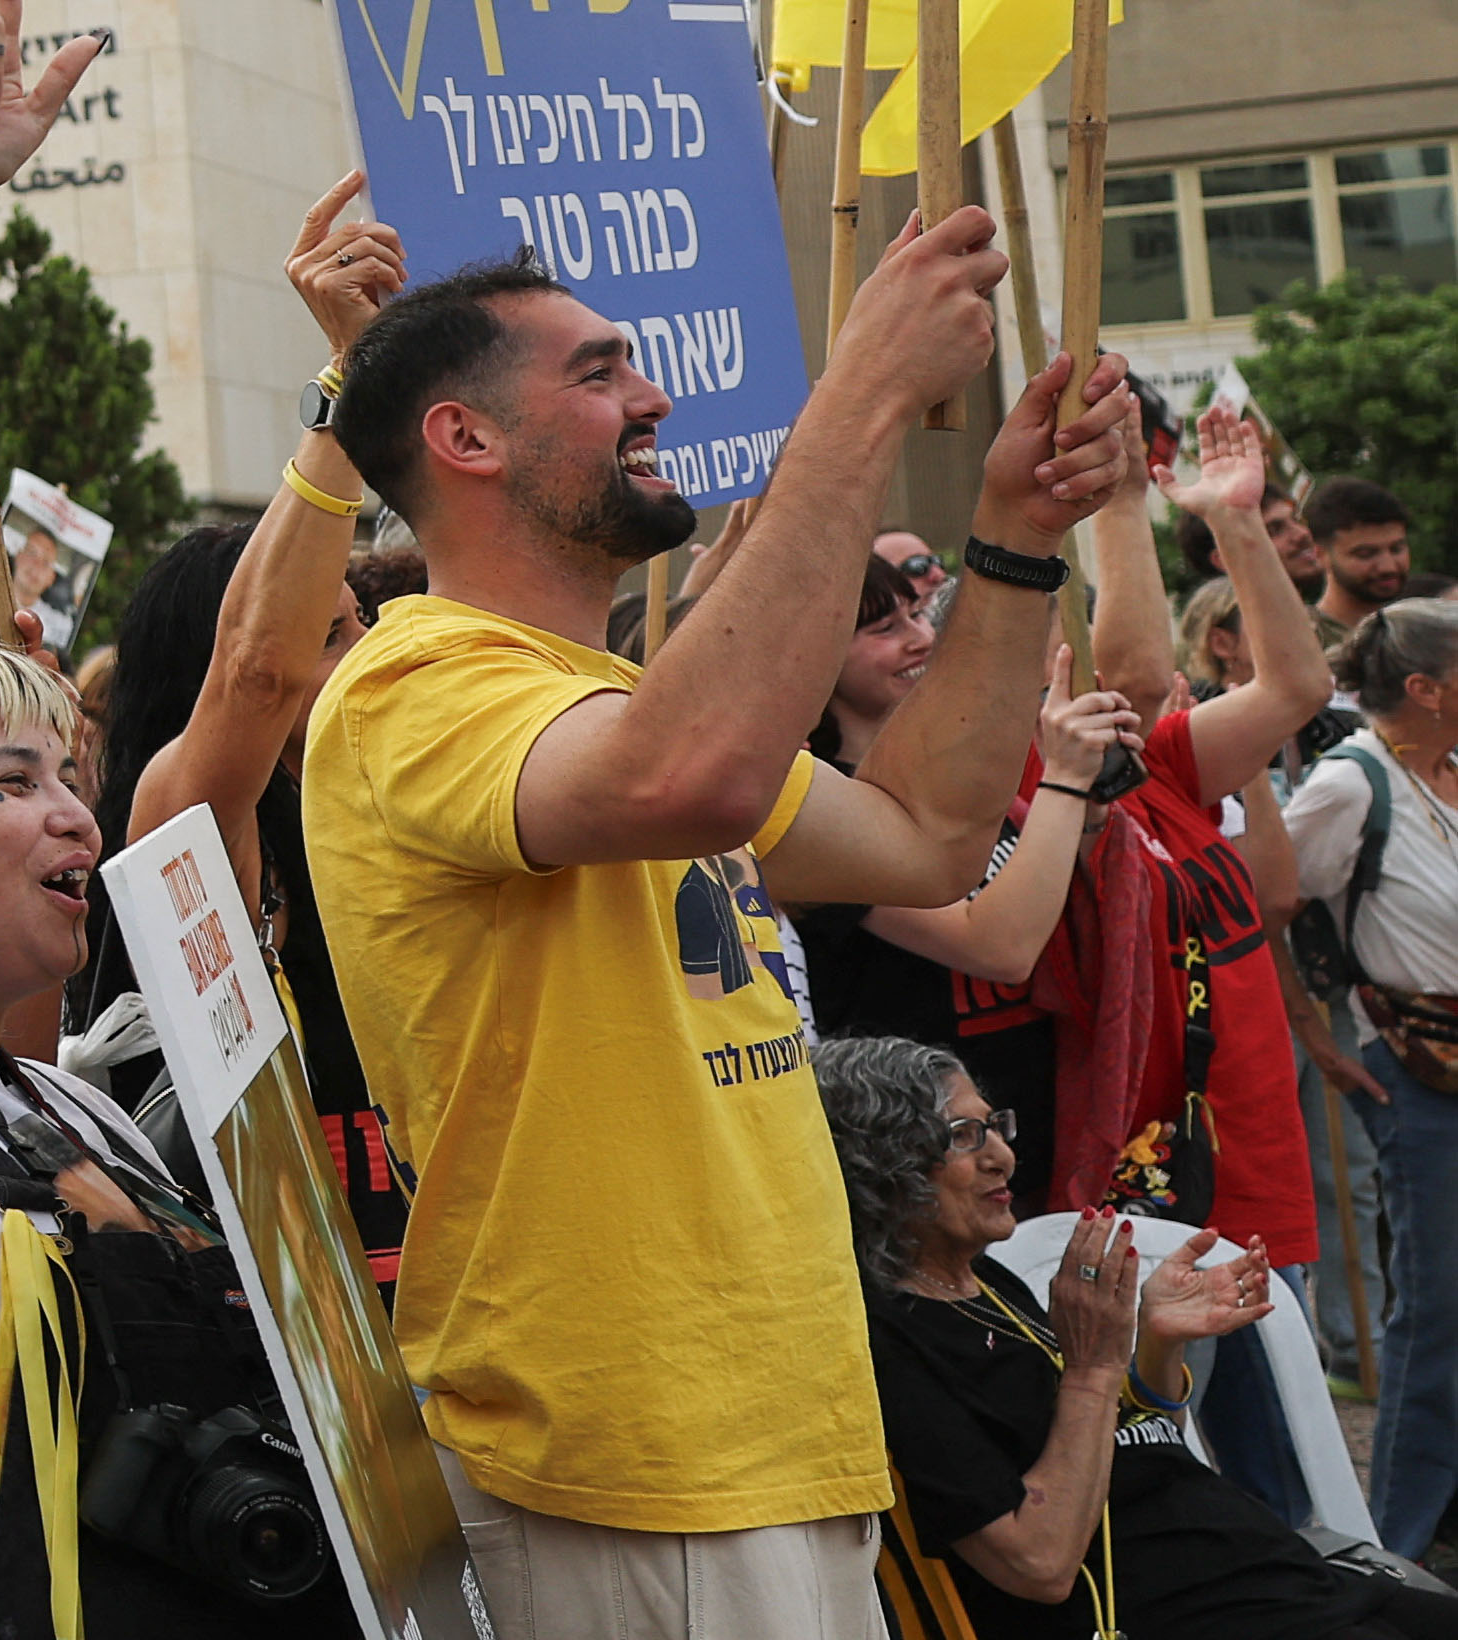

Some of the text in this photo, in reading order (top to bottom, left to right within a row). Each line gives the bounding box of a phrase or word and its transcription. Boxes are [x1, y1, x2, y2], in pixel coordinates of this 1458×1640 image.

[424, 76, 706, 196] כל כל חיכינו לך
[599, 188, 700, 276] כמה
[703, 1042, 743, 1087] לבד
[261, 1433, 303, 1458] Canon
